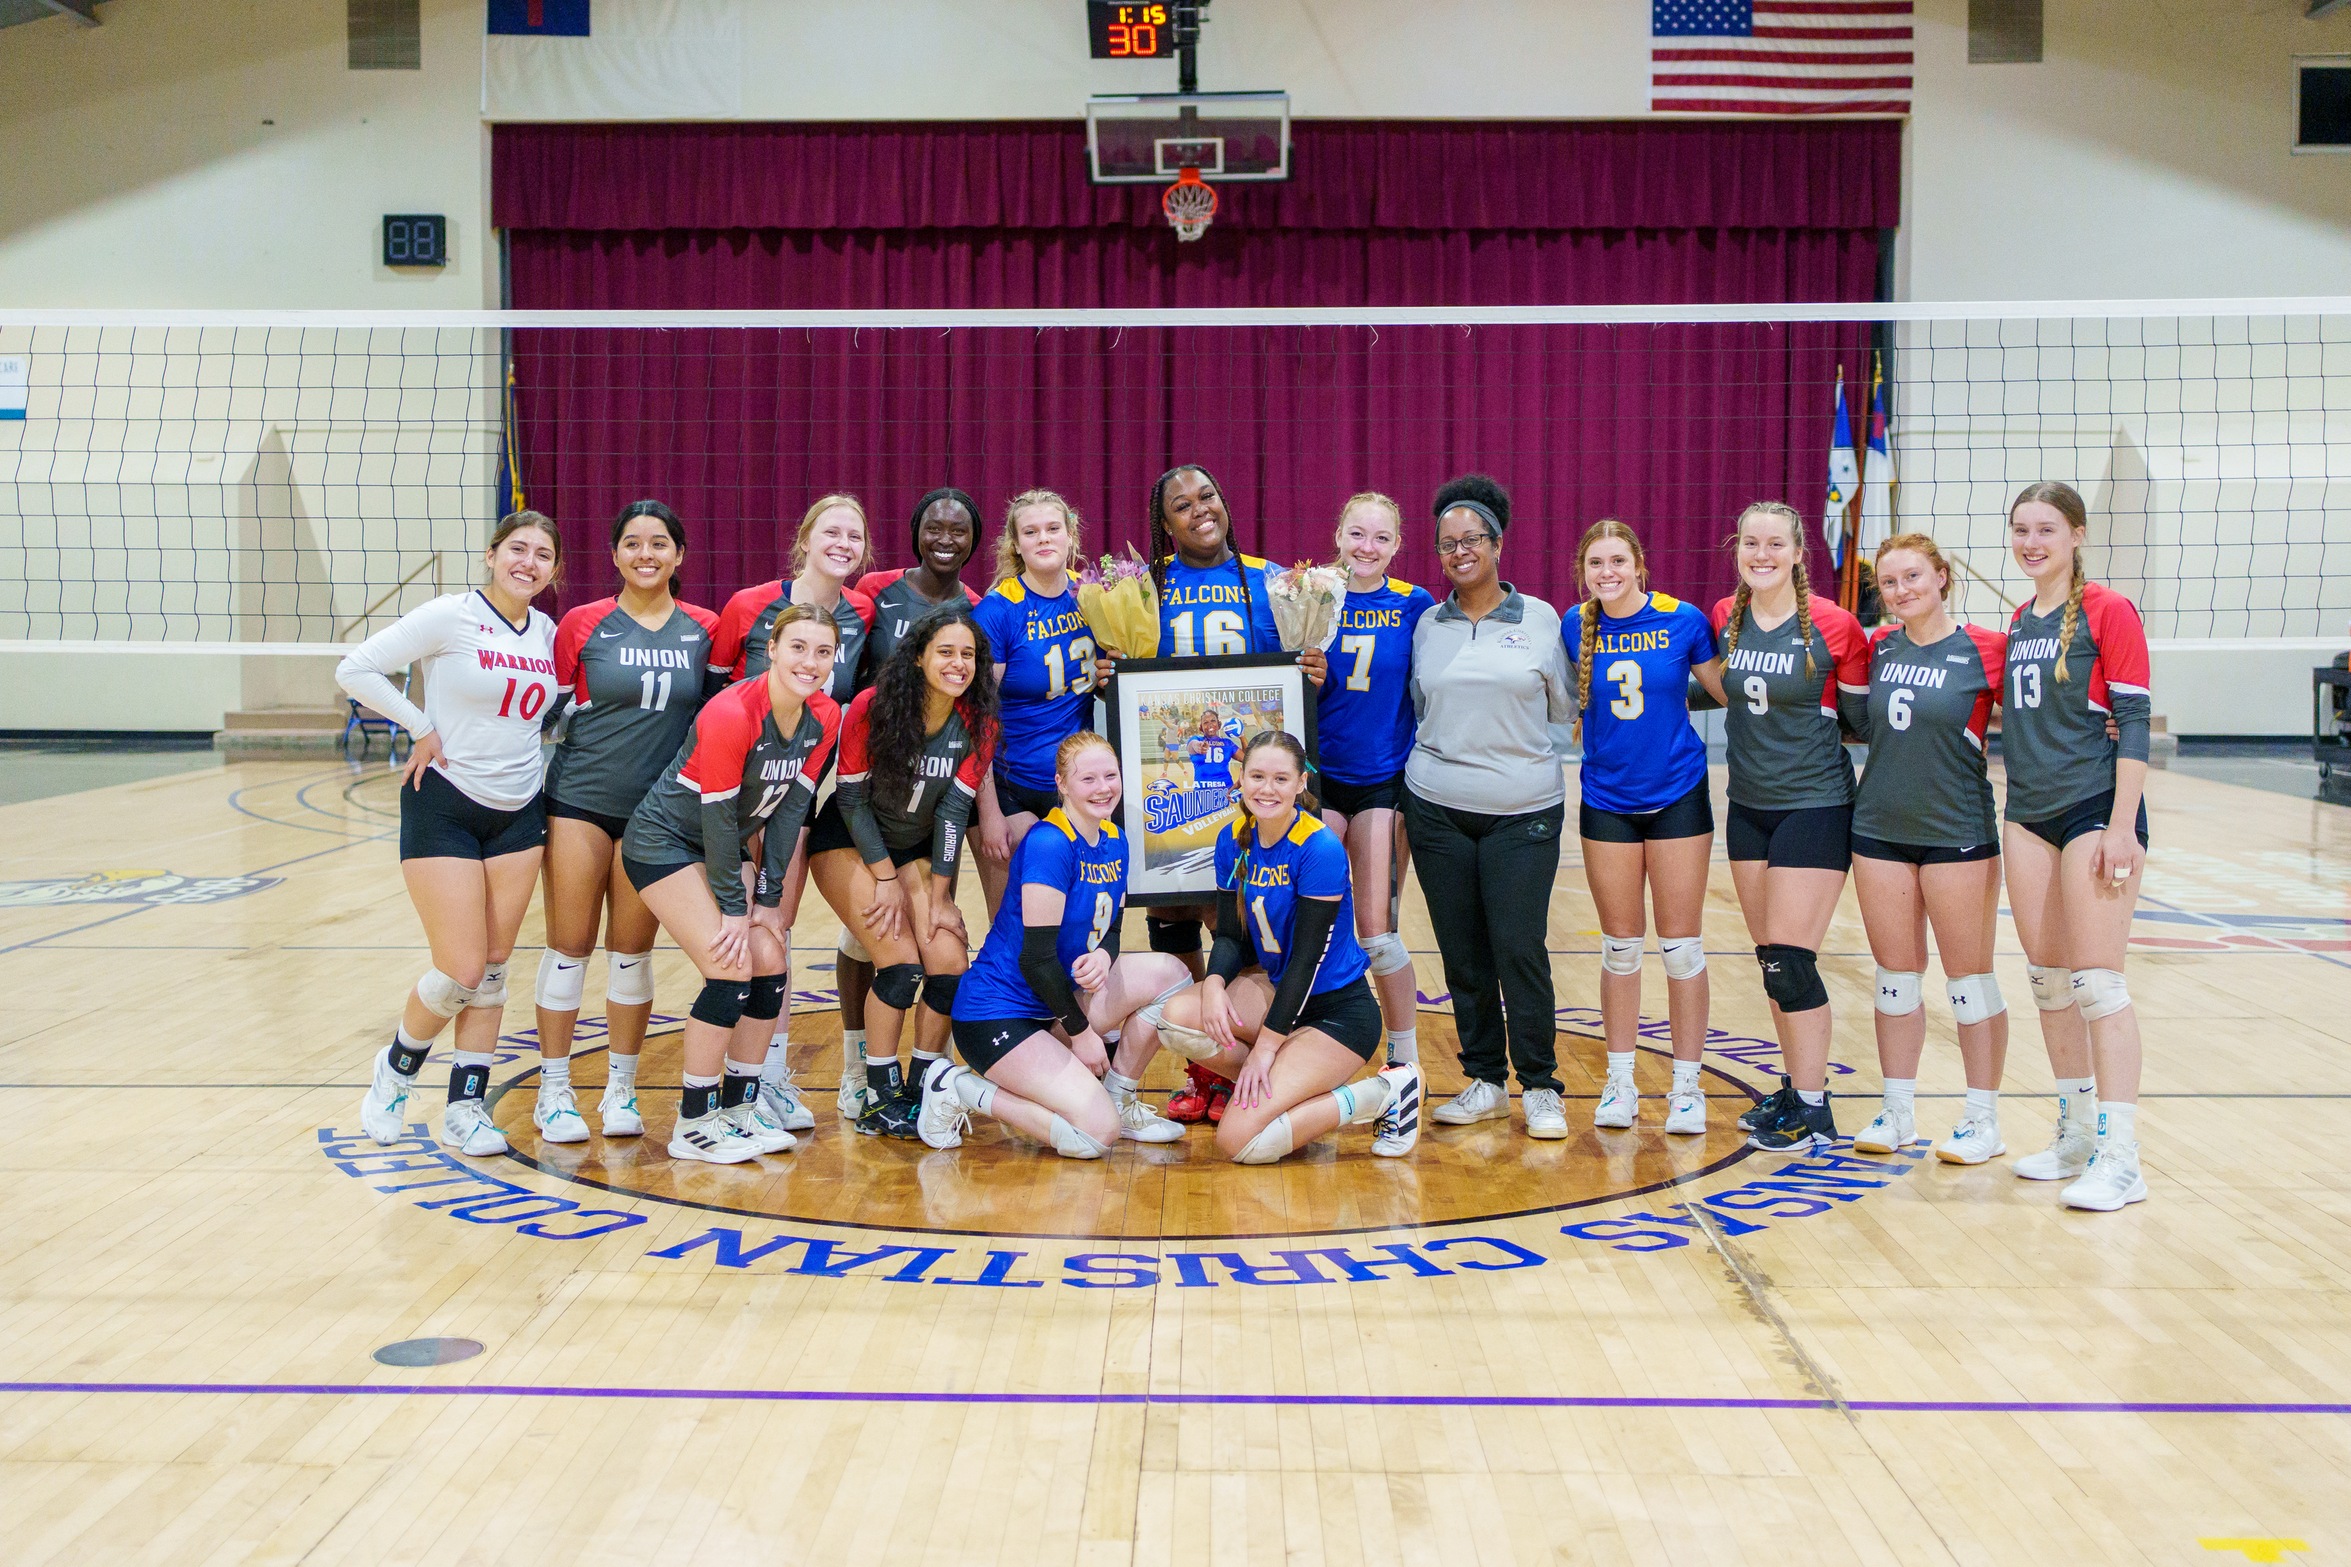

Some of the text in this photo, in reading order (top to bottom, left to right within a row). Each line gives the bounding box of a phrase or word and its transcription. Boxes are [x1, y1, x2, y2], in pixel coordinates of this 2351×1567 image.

[1119, 4, 1166, 25] 1:15
[1108, 23, 1157, 56] 30
[1027, 611, 1089, 641] FALCON
[1169, 610, 1246, 658] 16
[1336, 610, 1402, 629] LCONS
[1593, 629, 1671, 653] ALCONS
[2009, 638, 2060, 662] UNION
[620, 647, 690, 670] UNION
[1044, 635, 1098, 700] 13
[1341, 634, 1376, 692] 7
[1728, 648, 1795, 675] UNION
[1880, 662, 1948, 689] UNION
[497, 677, 546, 721] 10
[640, 670, 672, 711] 11
[1140, 688, 1281, 707] KANSAS CHRISTIAN COLLEGE
[1606, 660, 1644, 720] 3
[1743, 675, 1769, 715] 9
[2012, 663, 2042, 709] 13
[1888, 688, 1915, 731] 6
[1205, 746, 1225, 764] 16
[750, 783, 790, 819] 12
[907, 780, 925, 813] 1
[1183, 780, 1226, 789] LATRESA
[1143, 787, 1230, 832] SAUNDERS
[1182, 806, 1237, 836] VOLLEYBALL
[1086, 892, 1114, 953] 9
[1251, 895, 1282, 954] 1
[644, 1226, 1548, 1289] CHRISTIAN
